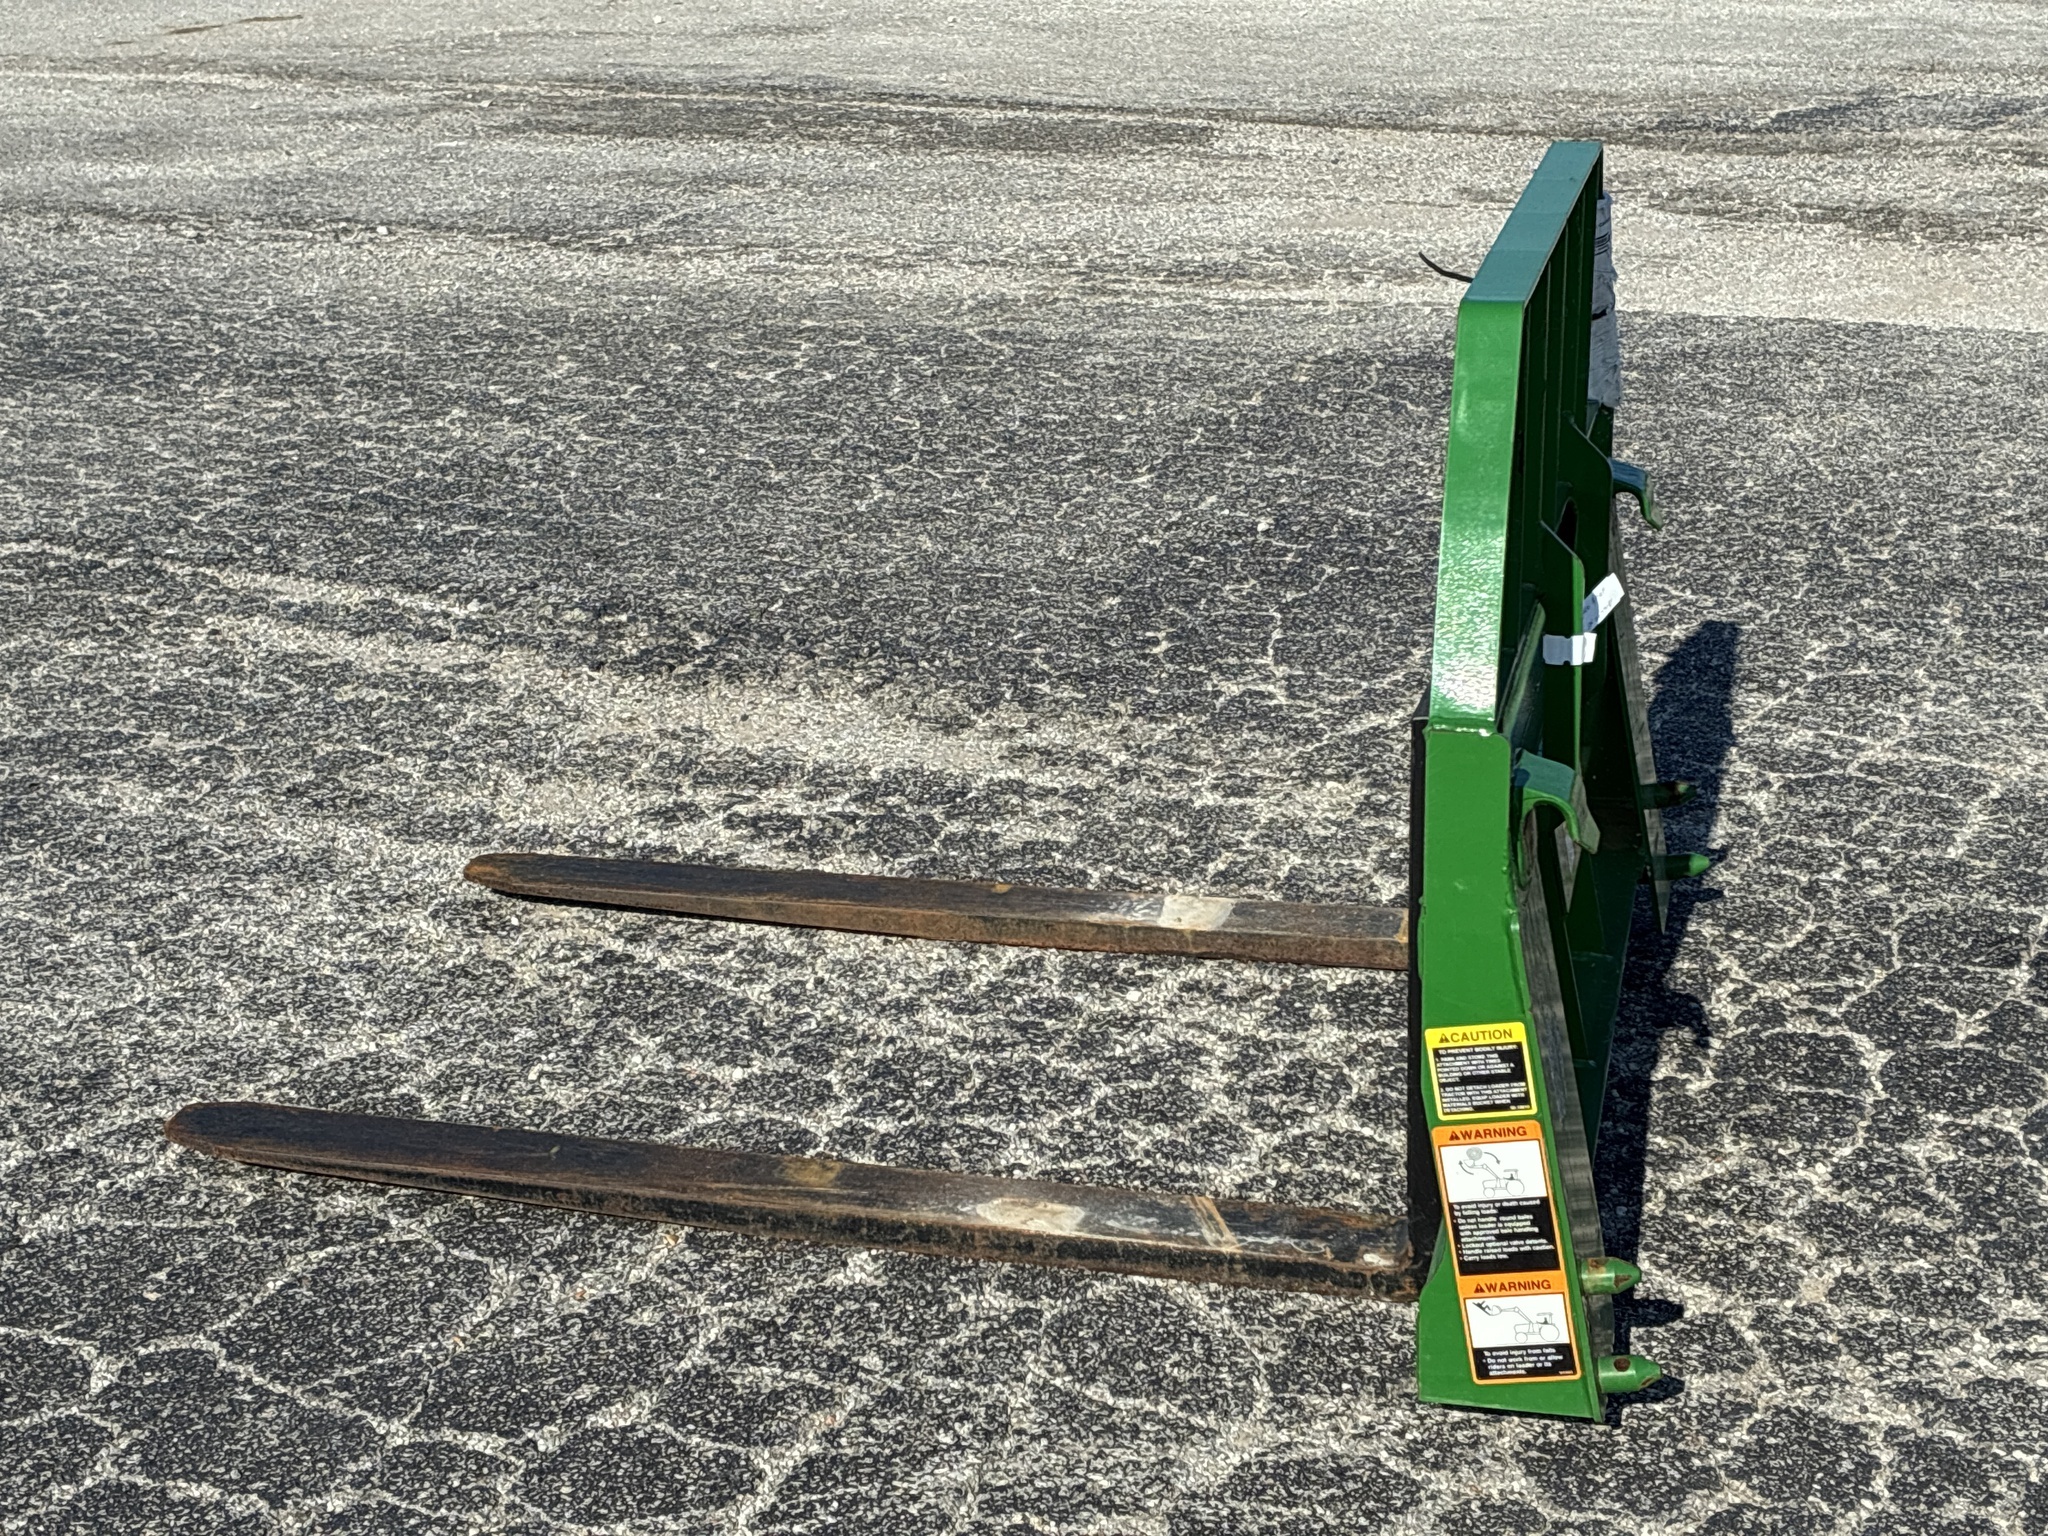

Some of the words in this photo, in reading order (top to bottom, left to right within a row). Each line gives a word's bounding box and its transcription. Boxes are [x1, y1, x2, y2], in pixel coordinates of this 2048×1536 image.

[1450, 1028, 1512, 1043] CAUTION
[1460, 1126, 1527, 1140] WARNING
[1484, 1280, 1551, 1292] WARNING
